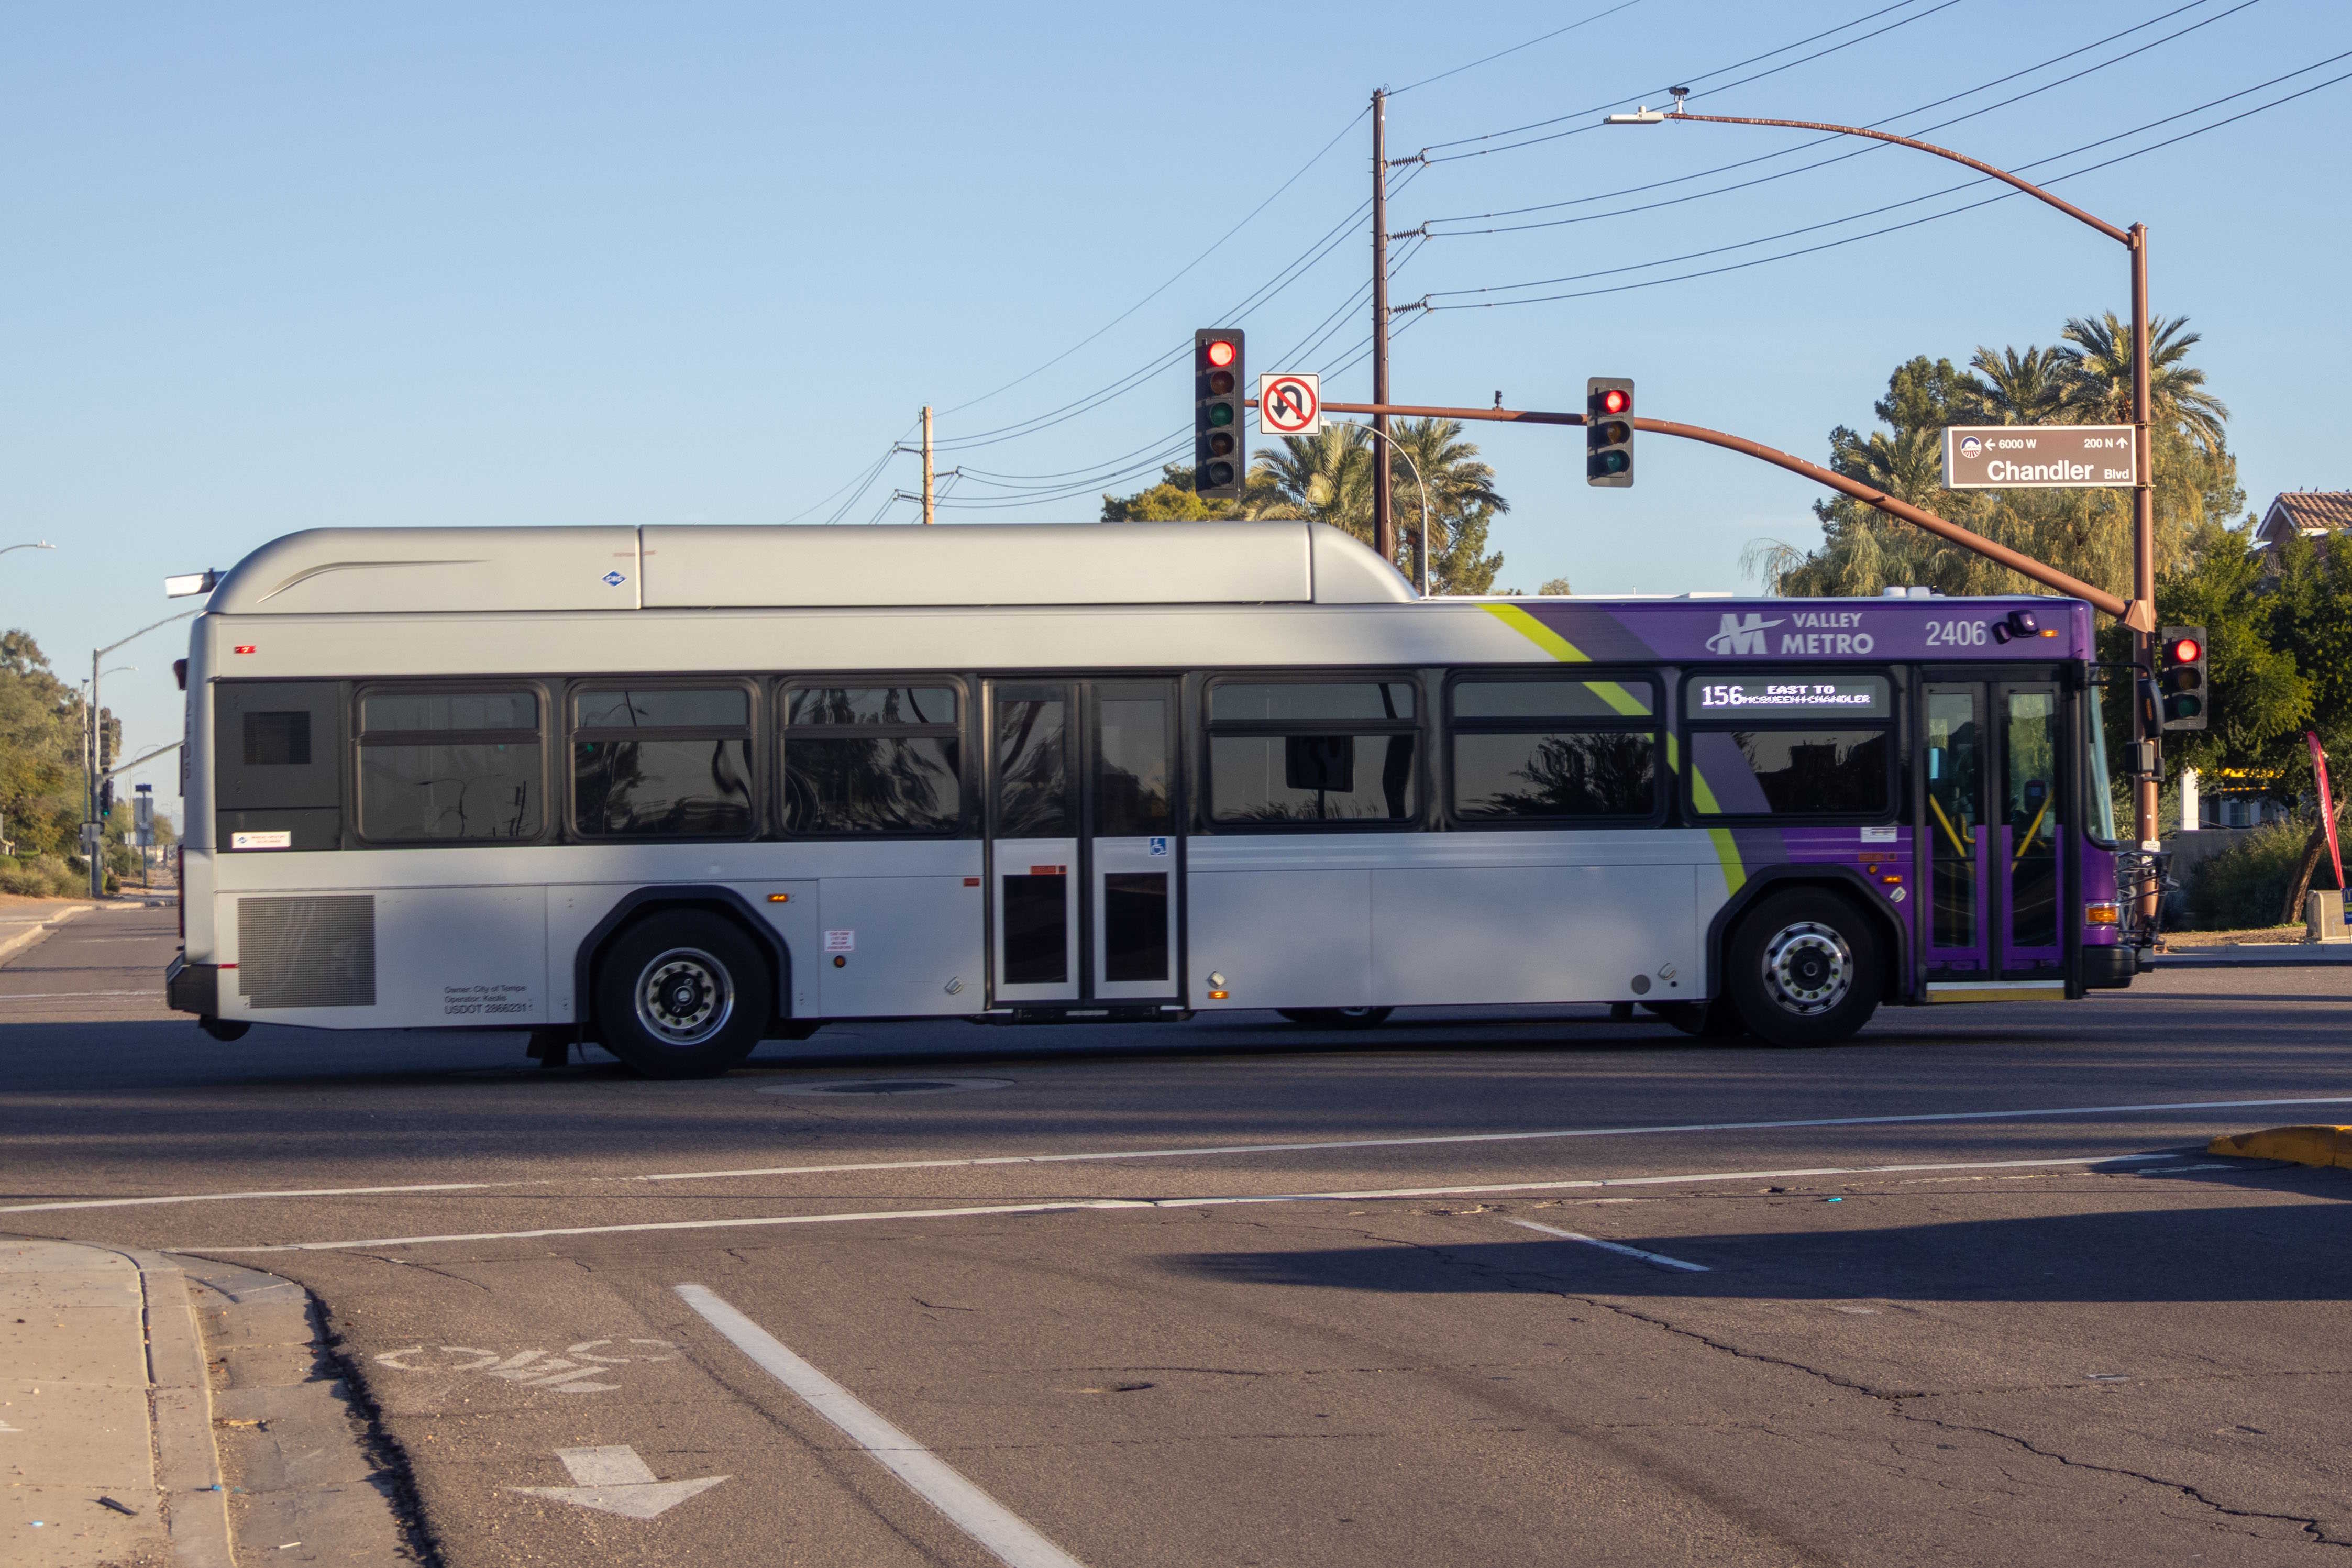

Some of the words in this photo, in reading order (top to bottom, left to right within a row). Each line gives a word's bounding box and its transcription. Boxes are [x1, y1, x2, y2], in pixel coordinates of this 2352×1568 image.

[1998, 439, 2024, 449] 6000
[2026, 439, 2037, 448] W
[2084, 438, 2103, 448] 200
[2105, 438, 2113, 448] N
[1987, 460, 2094, 481] Chandler
[2104, 469, 2129, 479] Blvd
[1791, 613, 1863, 628] VALLEY
[1926, 621, 1987, 646] 2406
[1781, 633, 1874, 654] METRO
[1702, 686, 1743, 705] 156
[1766, 685, 1808, 694] EAST
[1813, 685, 1836, 694] TO
[473, 985, 490, 993] City
[445, 1004, 483, 1014] USDOT
